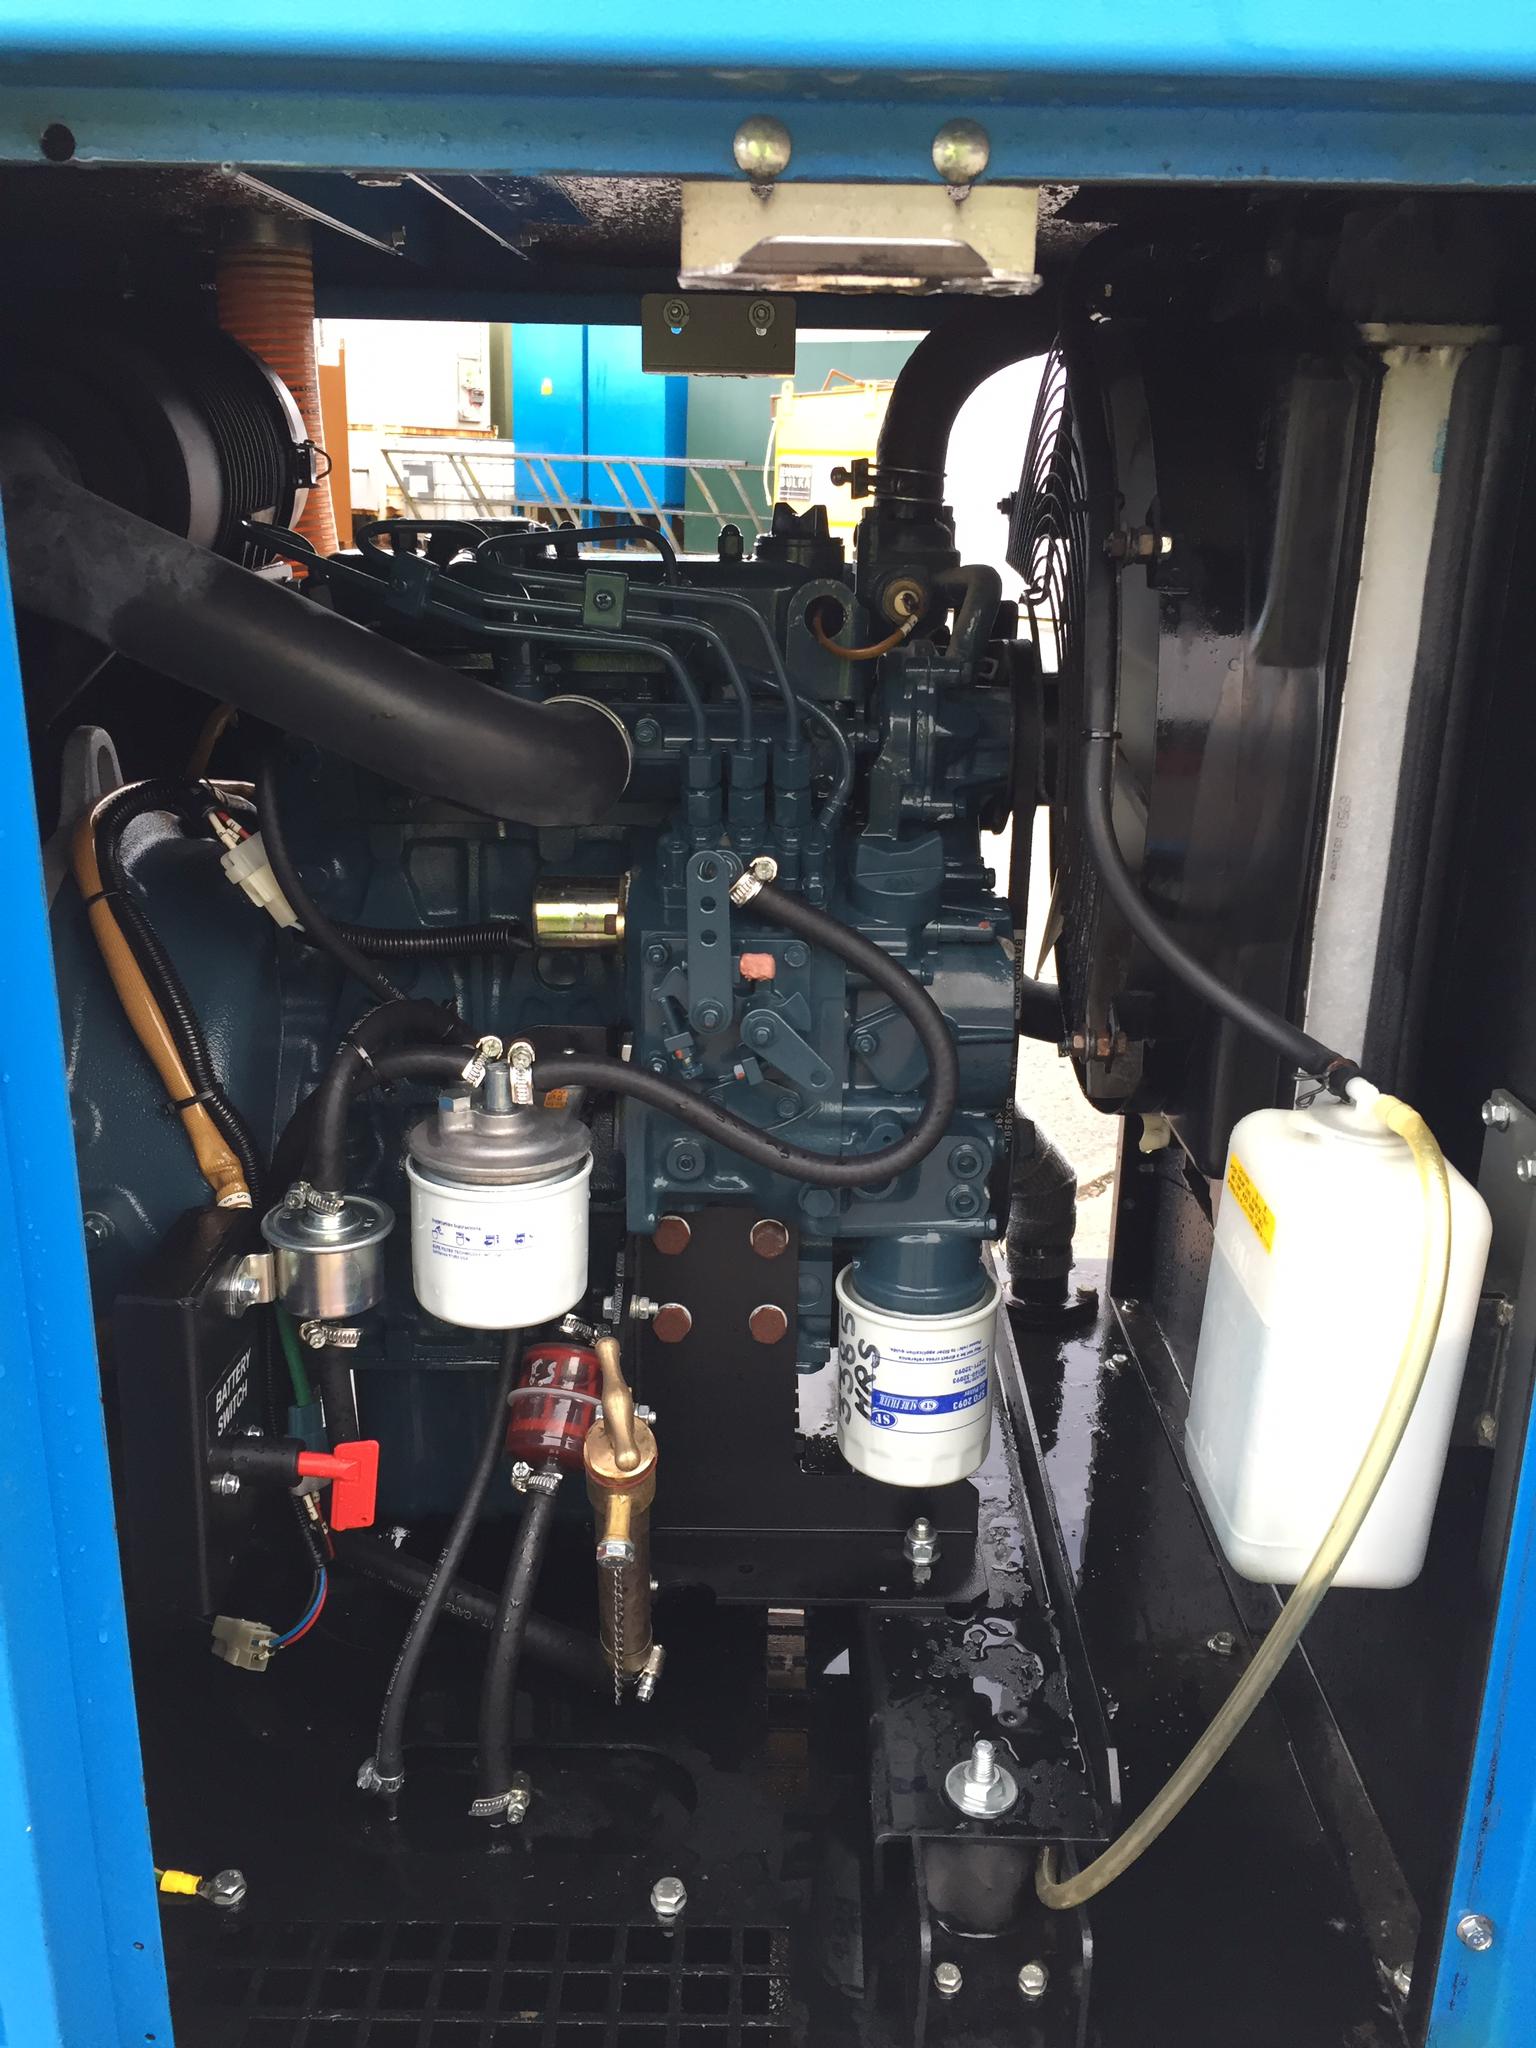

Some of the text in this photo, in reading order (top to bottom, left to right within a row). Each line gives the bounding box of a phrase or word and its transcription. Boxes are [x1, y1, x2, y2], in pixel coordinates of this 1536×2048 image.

[215, 1346, 252, 1414] BATTERY
[217, 1377, 248, 1437] SWITCH
[855, 1338, 880, 1421] HRS
[952, 1396, 973, 1410] 2093
[874, 1412, 891, 1425] SF
